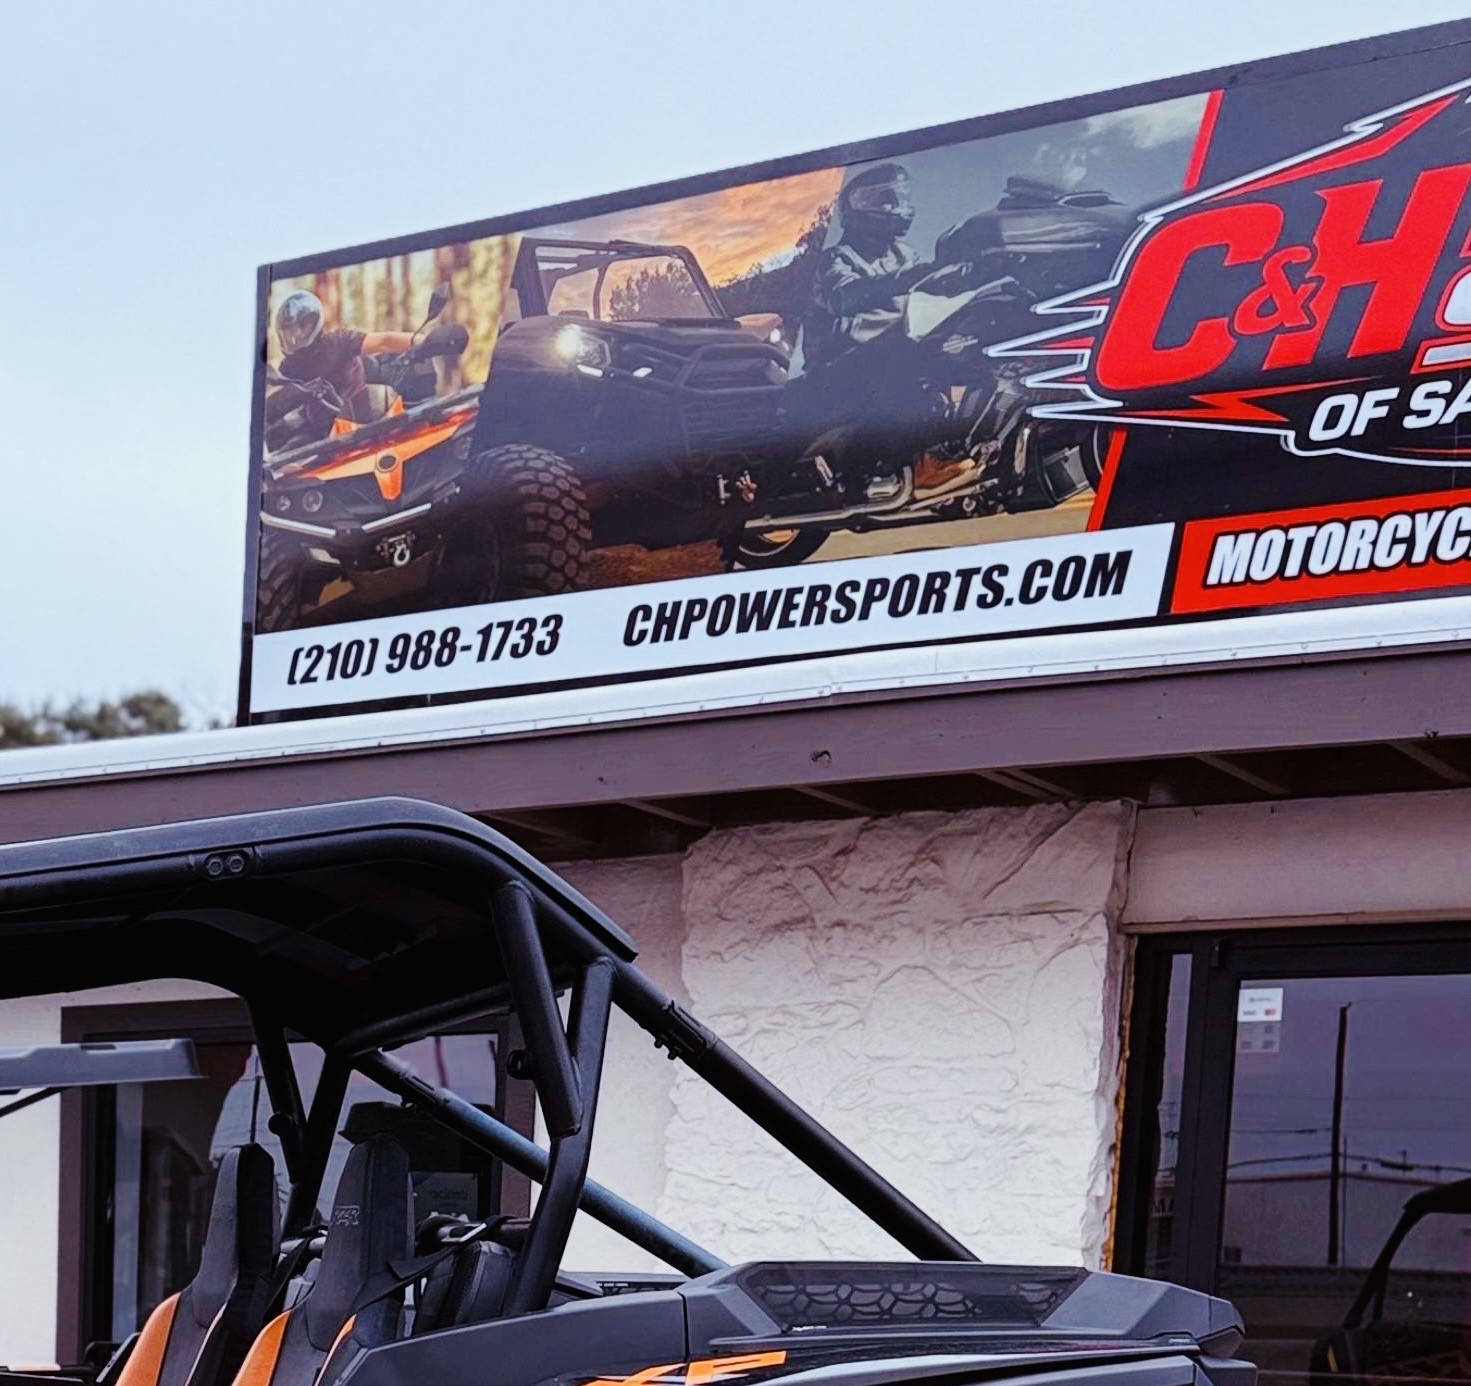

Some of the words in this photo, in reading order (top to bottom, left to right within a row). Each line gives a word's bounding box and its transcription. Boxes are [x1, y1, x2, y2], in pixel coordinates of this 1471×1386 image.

[1095, 163, 1471, 390] C&H
[1309, 387, 1400, 442] OF
[1206, 506, 1471, 586] MOTORCYC
[623, 549, 1133, 647] CHPOWERSPORTS.COM
[286, 638, 380, 686] (210)
[385, 614, 564, 674] 988-1733
